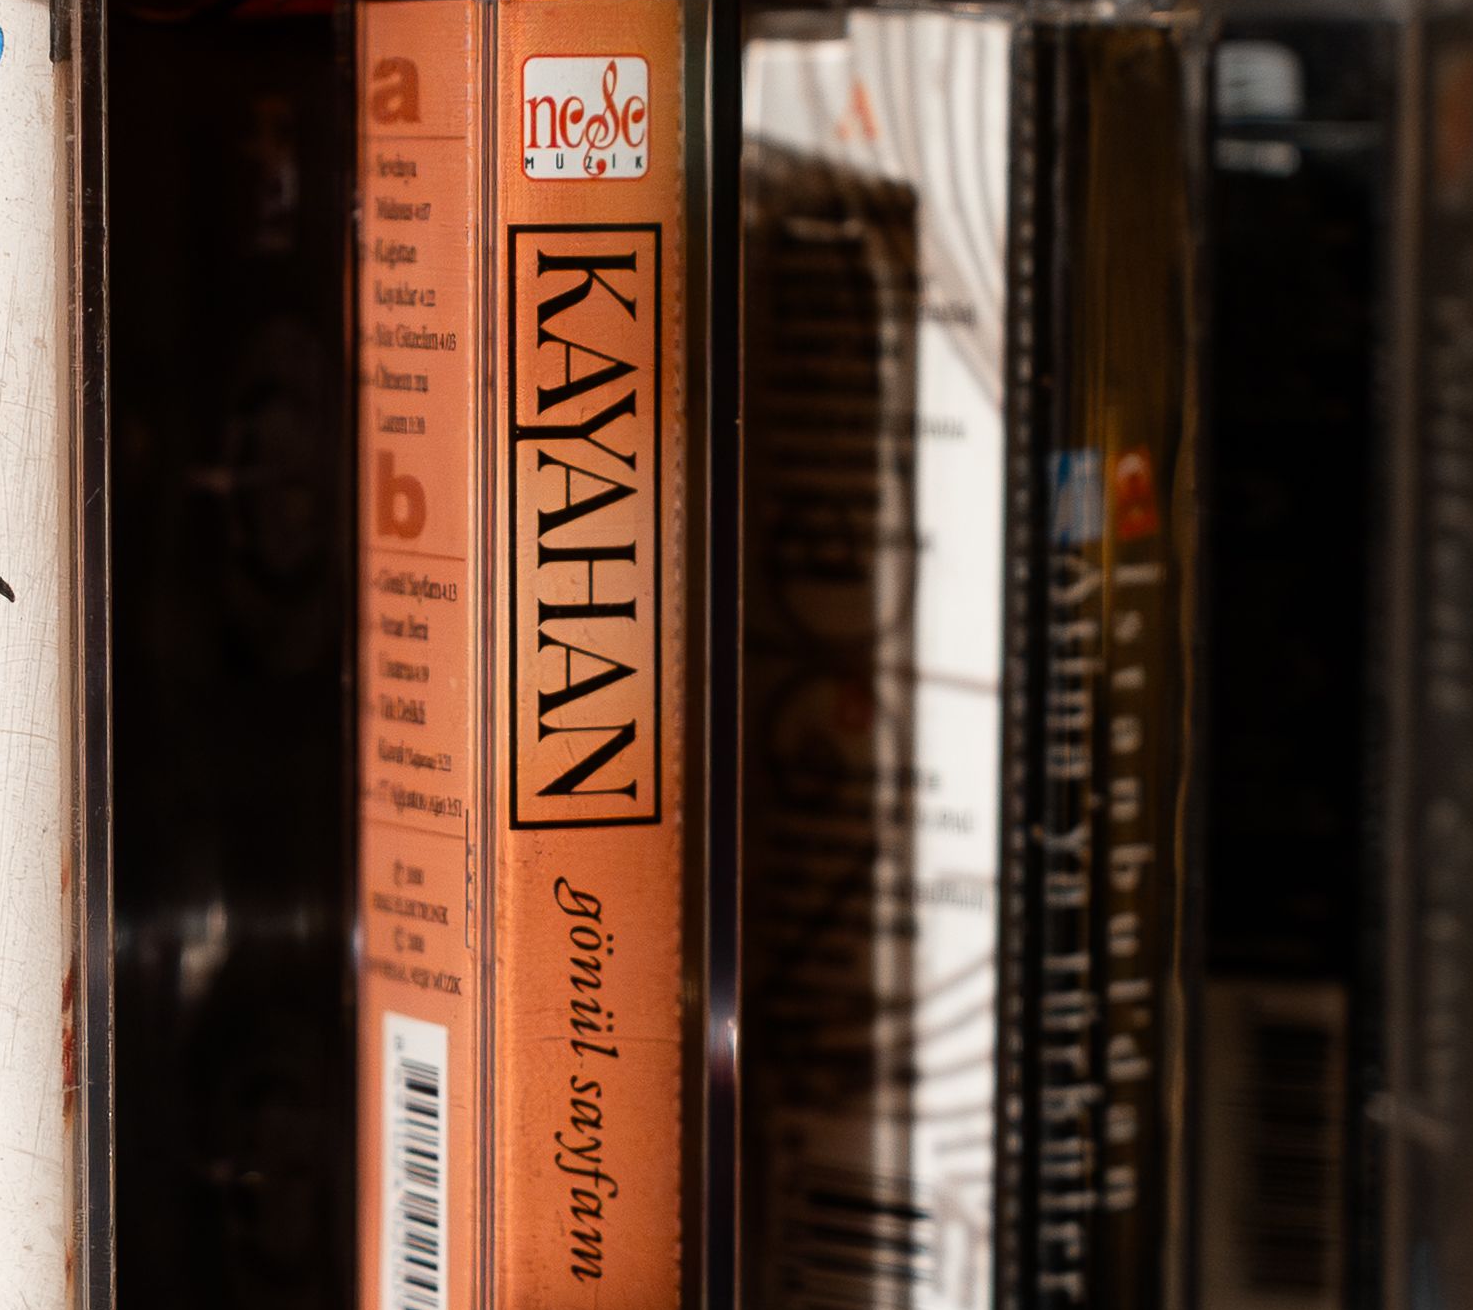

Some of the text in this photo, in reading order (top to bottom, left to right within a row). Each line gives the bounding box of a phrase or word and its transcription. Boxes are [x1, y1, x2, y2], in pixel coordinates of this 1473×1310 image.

[370, 56, 421, 125] a
[376, 448, 427, 540] b
[515, 249, 638, 799] KAYAHAN
[554, 876, 619, 1283] gönül sayfam
